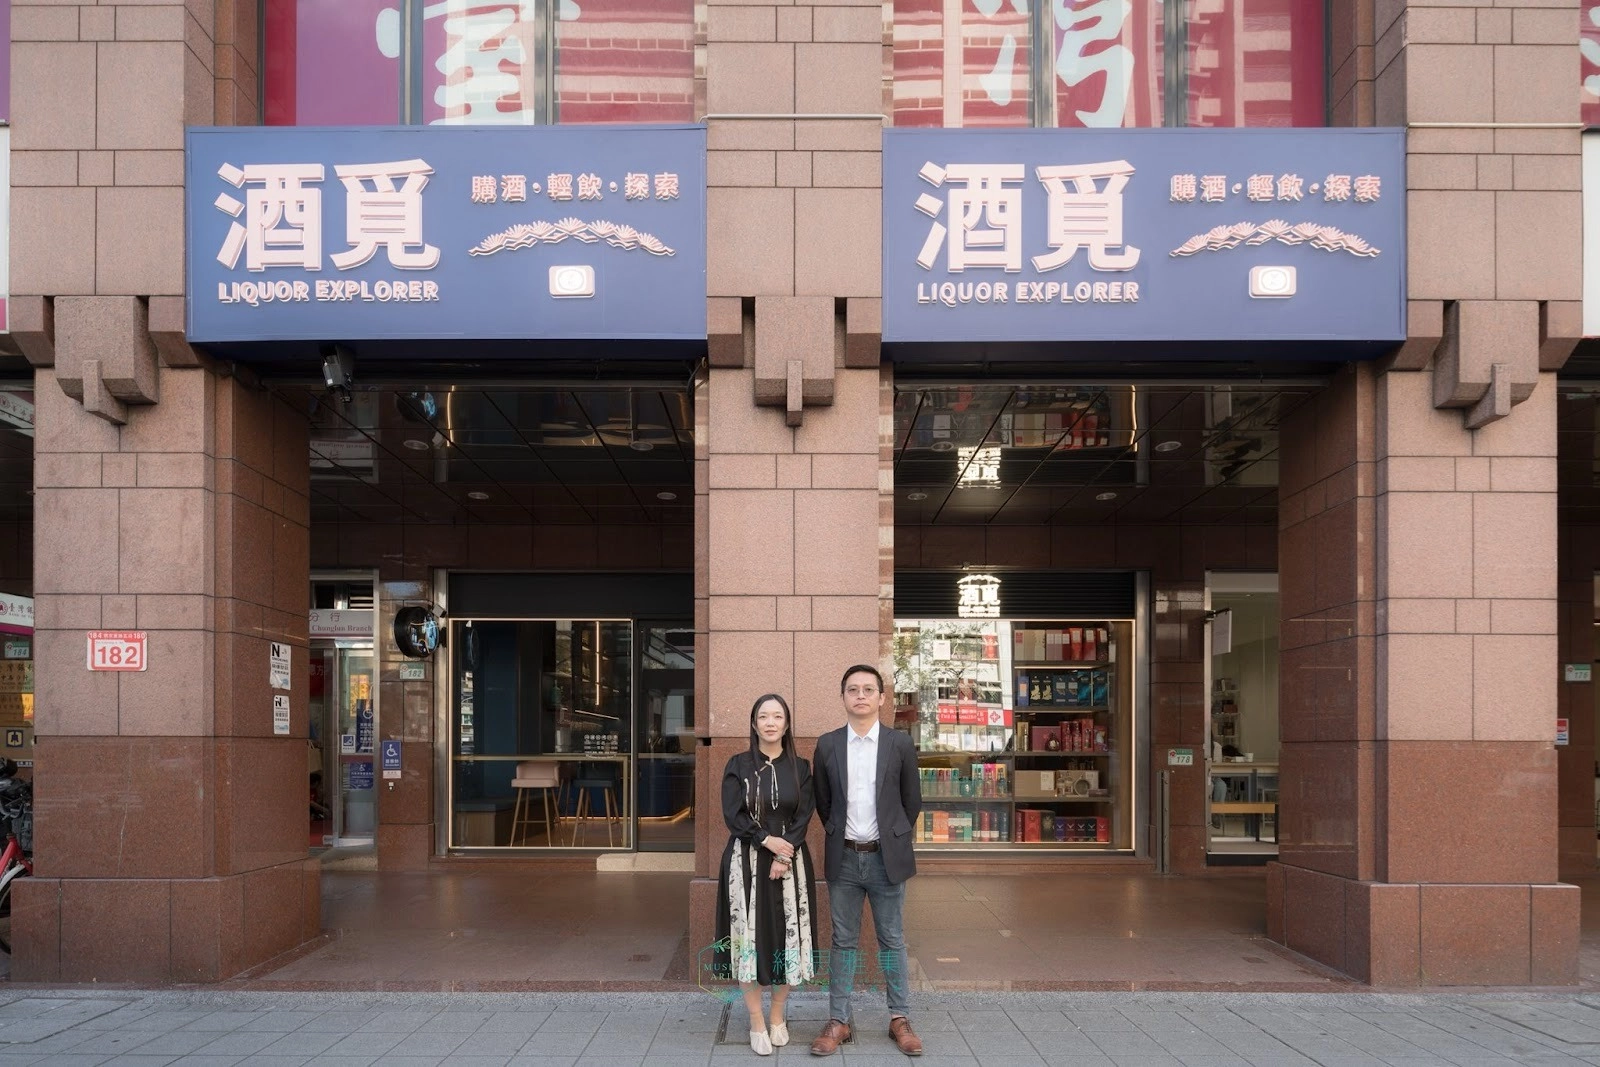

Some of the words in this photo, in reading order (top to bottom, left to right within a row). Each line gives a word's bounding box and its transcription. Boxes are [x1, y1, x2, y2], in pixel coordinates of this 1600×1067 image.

[214, 158, 441, 272] 酒覓
[914, 160, 1141, 273] 酒覓
[218, 280, 310, 307] LIQUOR
[315, 280, 439, 302] EXPLORER
[917, 281, 1009, 308] LIQUOR
[1015, 281, 1139, 304] EXPLORER
[958, 584, 1001, 606] 酒覓
[13, 648, 27, 656] 184
[97, 645, 138, 665] 182
[408, 669, 422, 678] 182
[1176, 755, 1191, 764] 178
